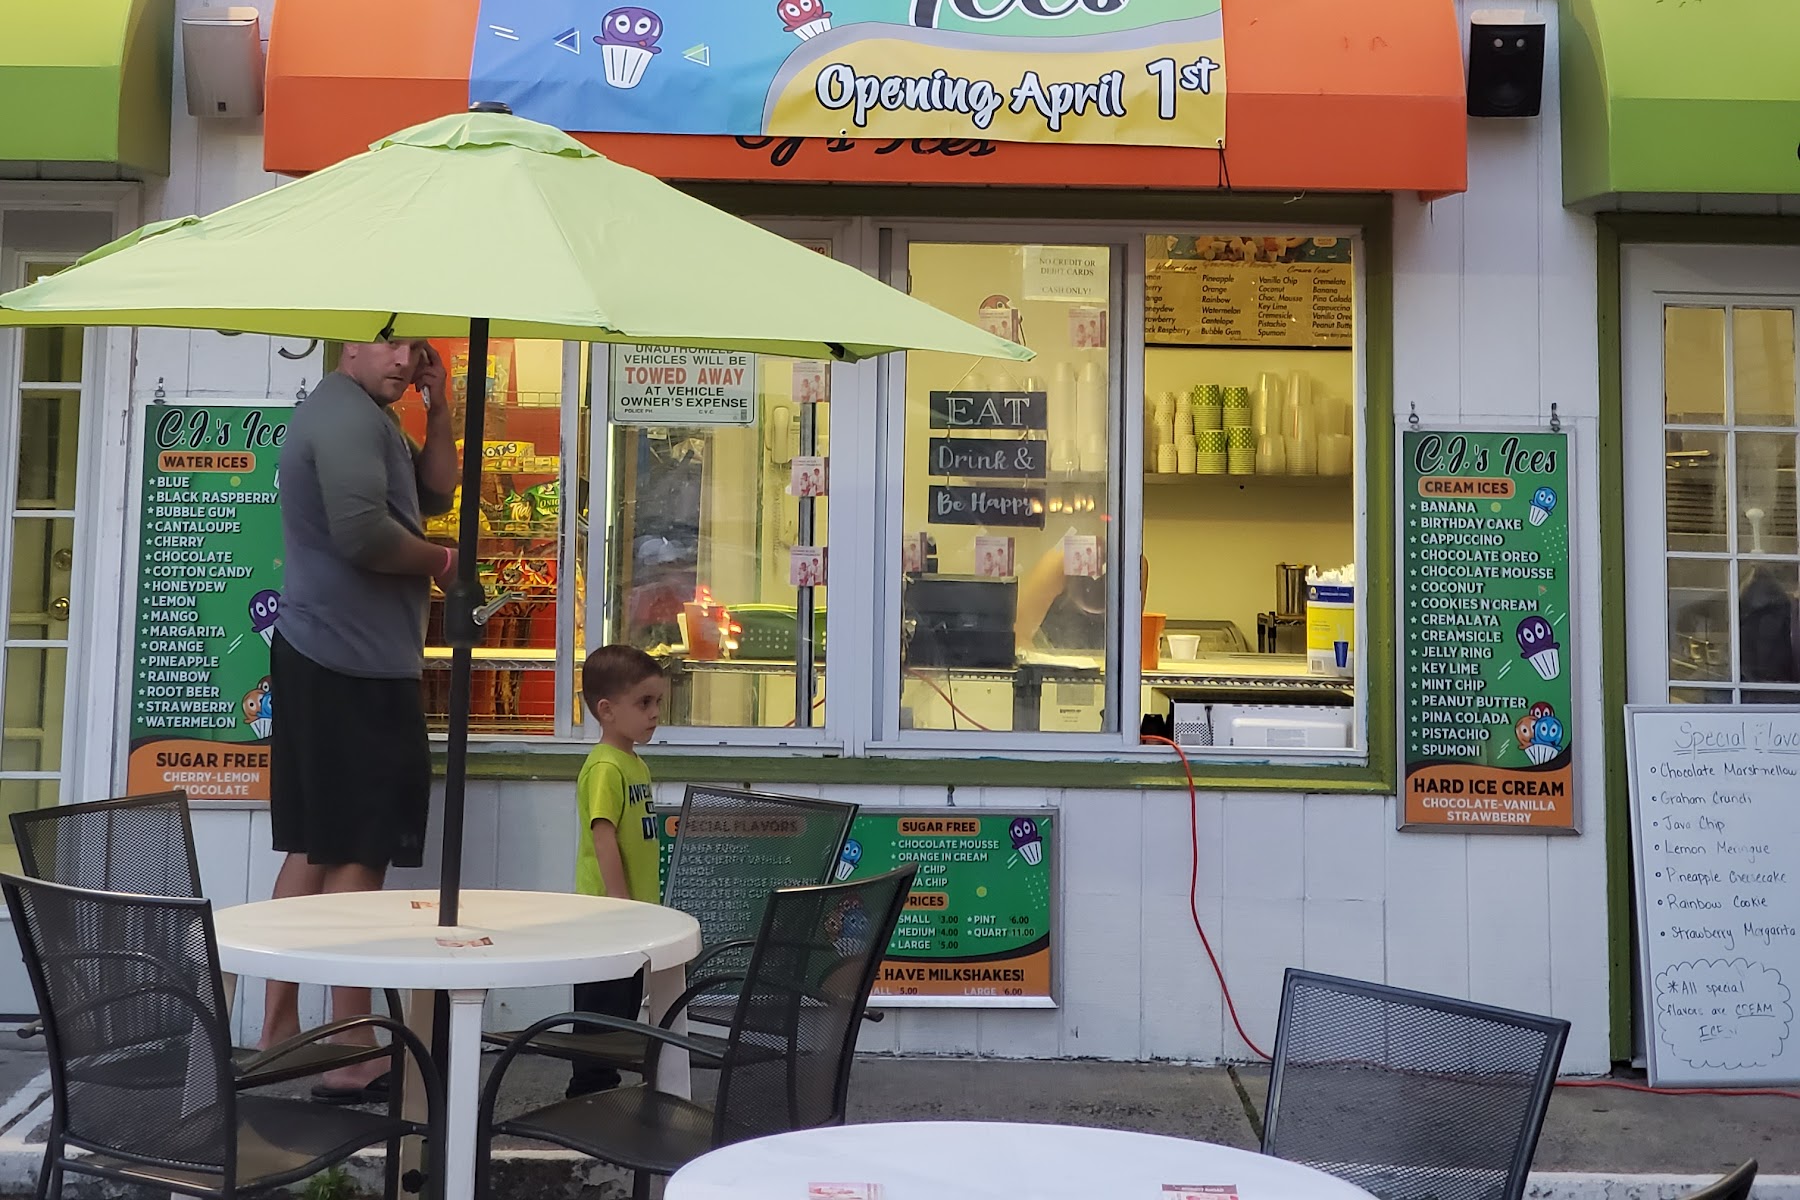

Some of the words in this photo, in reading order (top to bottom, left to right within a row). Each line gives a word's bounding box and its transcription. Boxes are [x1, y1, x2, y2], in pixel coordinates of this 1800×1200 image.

[816, 62, 1003, 132] Opening
[1009, 71, 1125, 133] April
[1147, 56, 1219, 119] 1st
[1067, 268, 1094, 276] CARDS
[1202, 275, 1235, 284] Pineapple
[1283, 276, 1298, 286] Chip
[1042, 286, 1064, 294] CASH
[1202, 285, 1228, 294] Orange
[1258, 285, 1285, 293] Coconut
[1313, 286, 1338, 294] Banana
[1201, 296, 1231, 304] Rainbow
[1202, 306, 1241, 314] Watermelon
[1258, 303, 1271, 311] Key
[1312, 303, 1350, 312] Cappuccino
[1258, 320, 1286, 328] Pistachio
[1312, 321, 1335, 329] Peanut
[624, 355, 687, 365] VEHICLES
[693, 356, 724, 365] WILL
[729, 356, 746, 365] BE
[625, 367, 687, 384] TOWED
[697, 368, 745, 385] AWAY
[645, 386, 661, 395] AT
[667, 387, 724, 396] VEHICLE
[621, 397, 683, 407] OWNER'S
[686, 398, 748, 408] EXPENSE
[946, 397, 1030, 426] EAT
[156, 409, 232, 450] C.J.'s
[242, 410, 287, 450] Ice
[485, 442, 517, 457] OTS
[1415, 434, 1489, 475] C.J.'s
[1500, 436, 1557, 476] Ices
[163, 456, 213, 469] WATER
[217, 457, 248, 469] ICES
[939, 445, 1010, 469] Drink
[1014, 447, 1036, 470] &
[157, 477, 190, 488] BLUE
[1425, 481, 1474, 494] CREAM
[1478, 482, 1509, 494] ICES
[156, 492, 199, 503] BLACK
[202, 492, 278, 504] RASPBERRY
[937, 491, 965, 516] Be
[971, 492, 1034, 516] Happy
[155, 506, 205, 518] BUBBLE
[208, 506, 236, 518] GUM
[1420, 502, 1476, 513] BANANA
[155, 521, 241, 533] CANTALOUPE
[1420, 518, 1484, 529] BIRTHDAY
[1486, 519, 1522, 530] CAKE
[154, 536, 205, 548] CHERRY
[1420, 533, 1504, 545] CAPPUCCINO
[153, 550, 233, 563] CHOCOLATE
[1421, 550, 1499, 562] CHOCOLATE
[1502, 551, 1539, 563] OREO
[152, 566, 206, 578] COTTON
[208, 566, 253, 578] CANDY
[1421, 566, 1499, 578] CHOCOLATE
[1502, 567, 1554, 579] MOUSSE
[152, 581, 226, 592] HONEYDEW
[1421, 581, 1484, 593] COCONUT
[151, 596, 196, 607] LEMON
[1421, 598, 1479, 610] COOKIES
[150, 610, 199, 622] MANGO
[1421, 614, 1499, 626] CREMALATA
[150, 625, 226, 637] MARGARITA
[1421, 630, 1501, 642] CREAMSICLE
[149, 640, 204, 652] ORANGE
[1422, 646, 1458, 658] JELLY
[1460, 647, 1492, 659] RING
[149, 655, 219, 667] PINEAPPLE
[1422, 663, 1447, 674] KEY
[1449, 663, 1479, 675] LIME
[147, 670, 210, 682] RAINBOW
[147, 685, 184, 697] ROOT
[185, 685, 220, 697] BEER
[1422, 679, 1452, 690] MINT
[1455, 679, 1485, 691] CHIP
[146, 701, 235, 713] STRAWBERRY
[1422, 695, 1475, 707] PEANUT
[1477, 697, 1526, 708] BUTTER
[145, 716, 236, 728] WATERMELON
[1422, 711, 1453, 723] PINA
[1455, 712, 1510, 724] COLADA
[1422, 728, 1490, 740] PISTACHIO
[1675, 721, 1746, 759] Special
[1422, 744, 1480, 756] SPUMONI
[156, 752, 218, 768] SUGAR
[223, 752, 268, 768] FREE
[1660, 762, 1715, 778] Chocolate
[163, 771, 260, 783] CHERRY-LEMON
[1414, 778, 1464, 793] HARD
[1469, 780, 1497, 795] ICE
[1502, 780, 1564, 796] CREAM
[1422, 797, 1556, 811] CHOCOLATE-VANILLA
[1660, 791, 1707, 805] Graham
[1447, 811, 1531, 823] STRAWBERRY
[902, 822, 943, 832] SUGAR
[946, 822, 976, 832] FREE
[1662, 815, 1691, 831] Java
[1699, 815, 1725, 835] Chip
[898, 840, 957, 849] CHOCOLATE
[959, 840, 999, 849] MOUSSE
[1665, 840, 1707, 854] Lemon
[898, 853, 939, 861] ORANGE
[941, 853, 952, 861] IN
[954, 853, 988, 862] CREAM
[924, 865, 946, 874] CHIP
[925, 878, 948, 887] CHIP
[1666, 893, 1722, 910] Rainbow
[1733, 895, 1768, 908] Cookie
[899, 915, 930, 924] SMALL
[974, 916, 996, 924] PINT
[898, 928, 936, 937] MEDIUM
[974, 928, 1008, 937] QUART
[1671, 926, 1735, 951] Strawberry
[1743, 922, 1796, 946] Margarita
[898, 940, 931, 949] LARGE
[884, 969, 925, 981] HAVE
[929, 969, 1025, 982] MILKSHAKES!
[964, 987, 997, 995] LARGE
[1706, 981, 1745, 997] special
[1711, 1007, 1726, 1016] are
